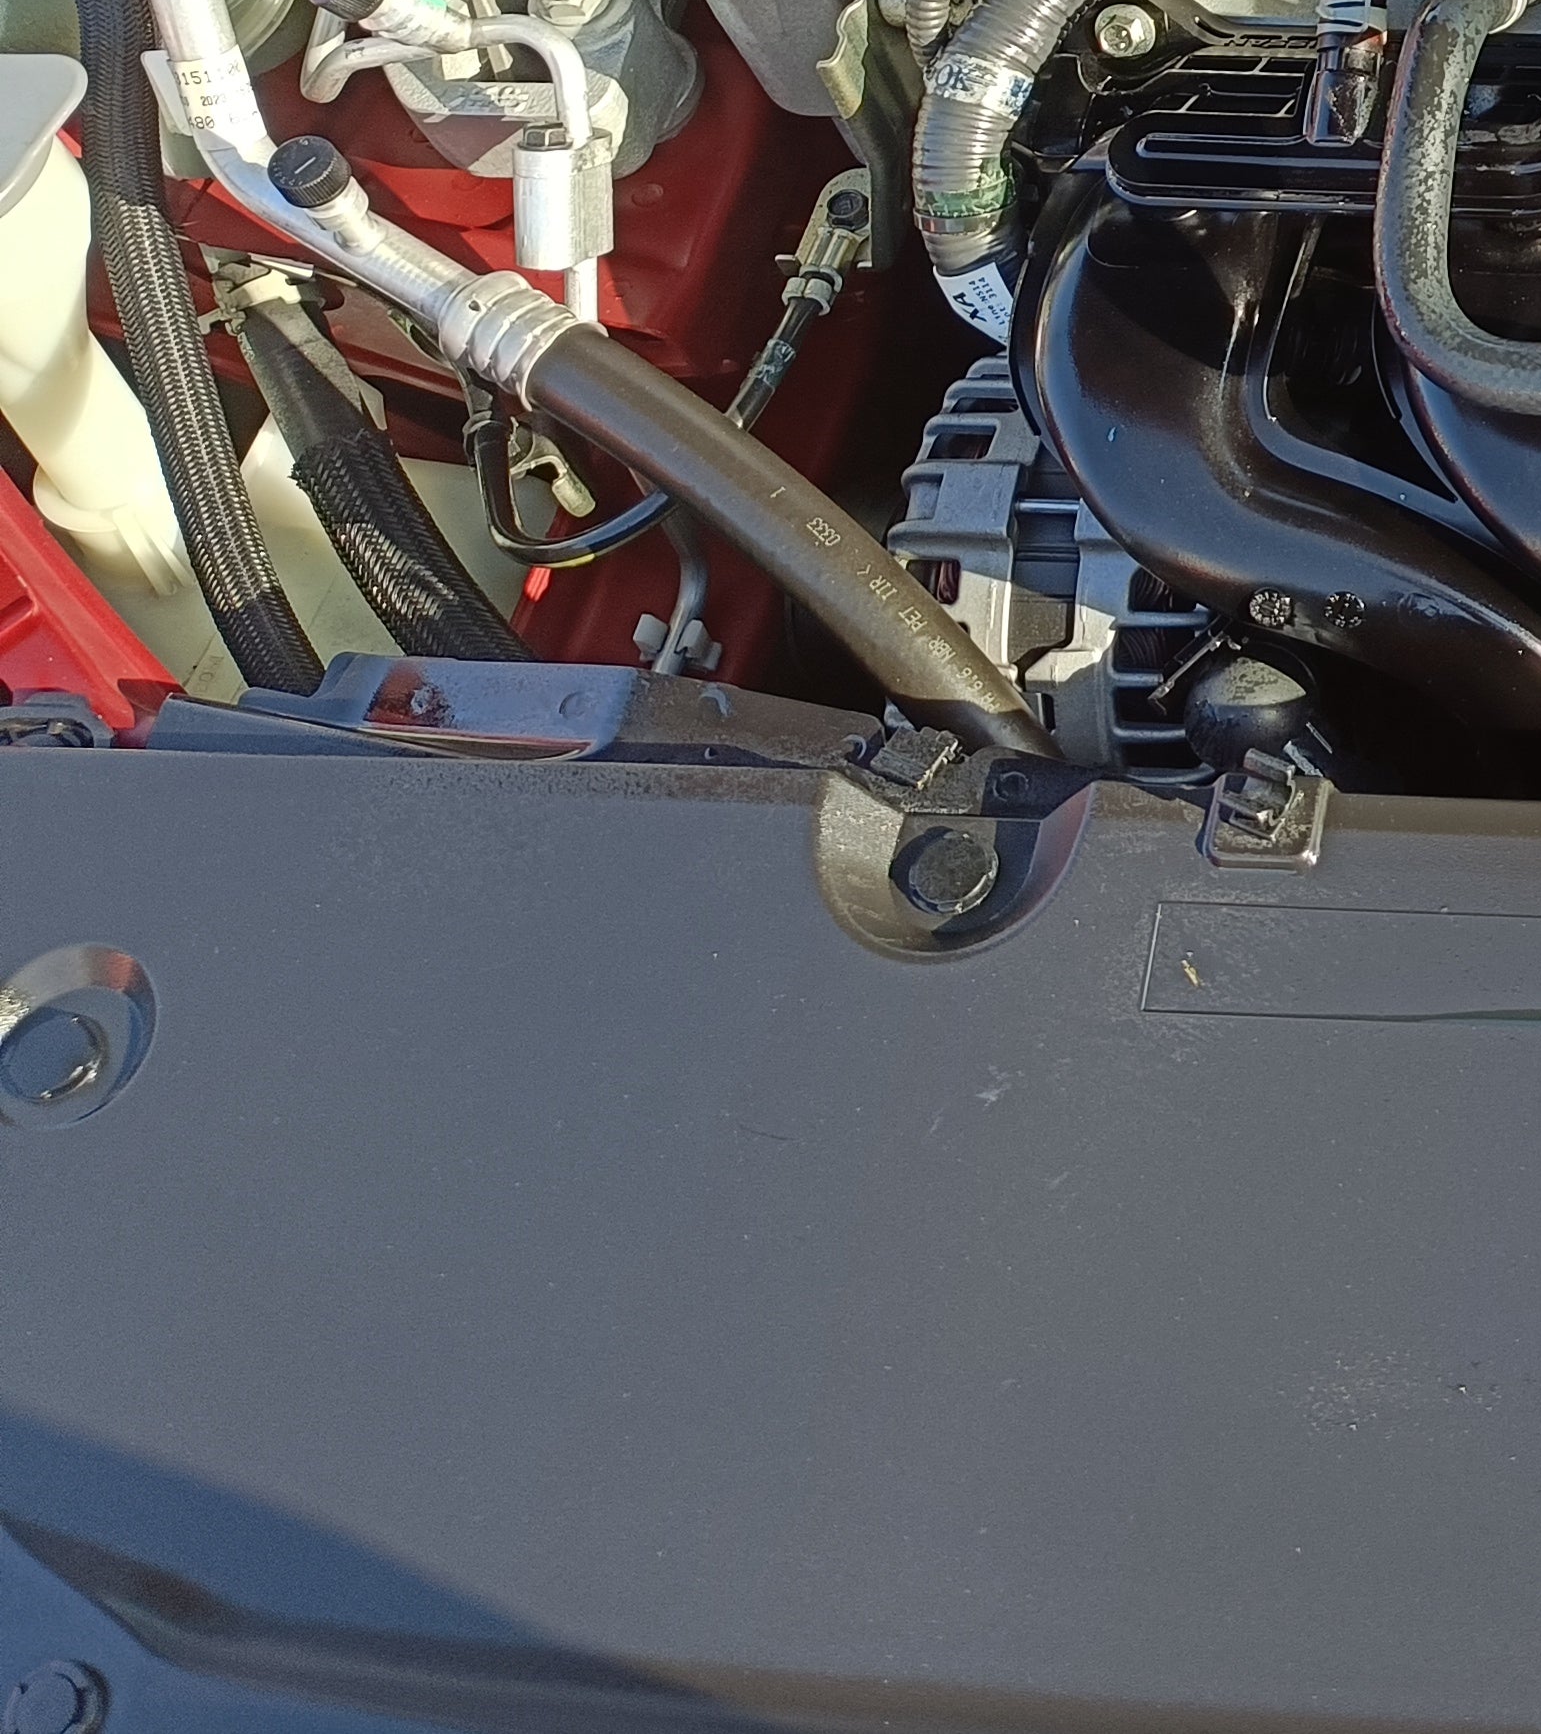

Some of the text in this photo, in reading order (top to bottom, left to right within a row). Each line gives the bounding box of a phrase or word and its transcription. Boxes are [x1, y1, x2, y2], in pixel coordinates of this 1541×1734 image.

[952, 292, 987, 323] XA
[868, 571, 898, 603] IIR
[895, 600, 929, 635] PET
[924, 632, 957, 666] NBR
[954, 662, 986, 695] 6.6
